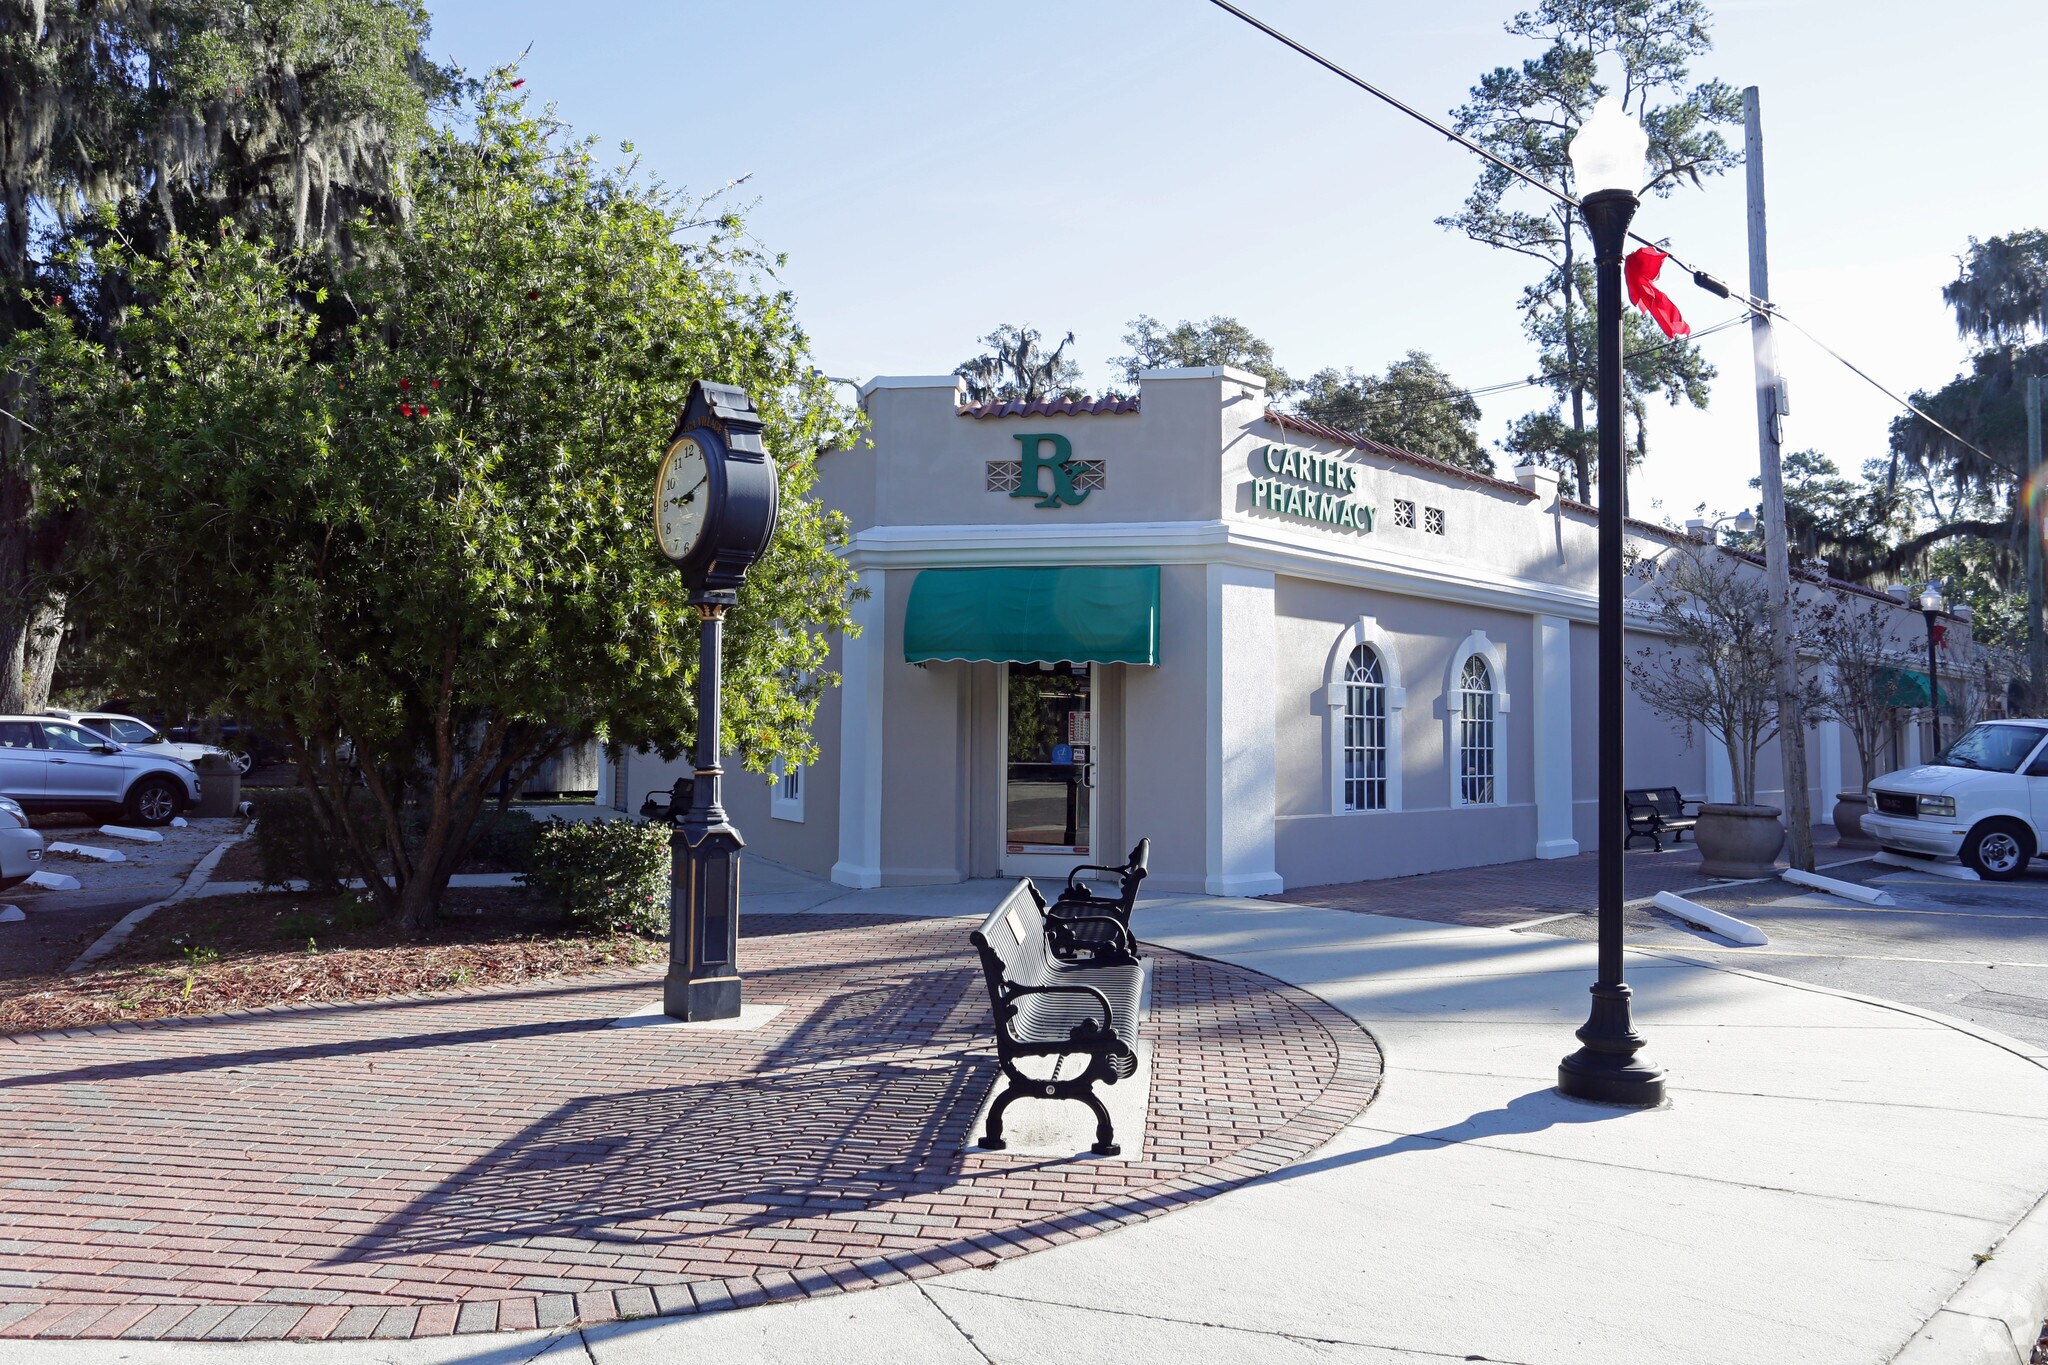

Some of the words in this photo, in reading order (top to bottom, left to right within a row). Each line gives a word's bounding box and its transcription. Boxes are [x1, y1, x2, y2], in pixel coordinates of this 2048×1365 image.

[684, 444, 694, 459] 12
[674, 457, 682, 470] 11
[1264, 443, 1358, 493] CARTERS
[667, 478, 675, 491] 10
[663, 500, 668, 512] 9
[1252, 478, 1378, 533] PHARMACY
[666, 522, 671, 535] 8
[674, 539, 679, 550] 7
